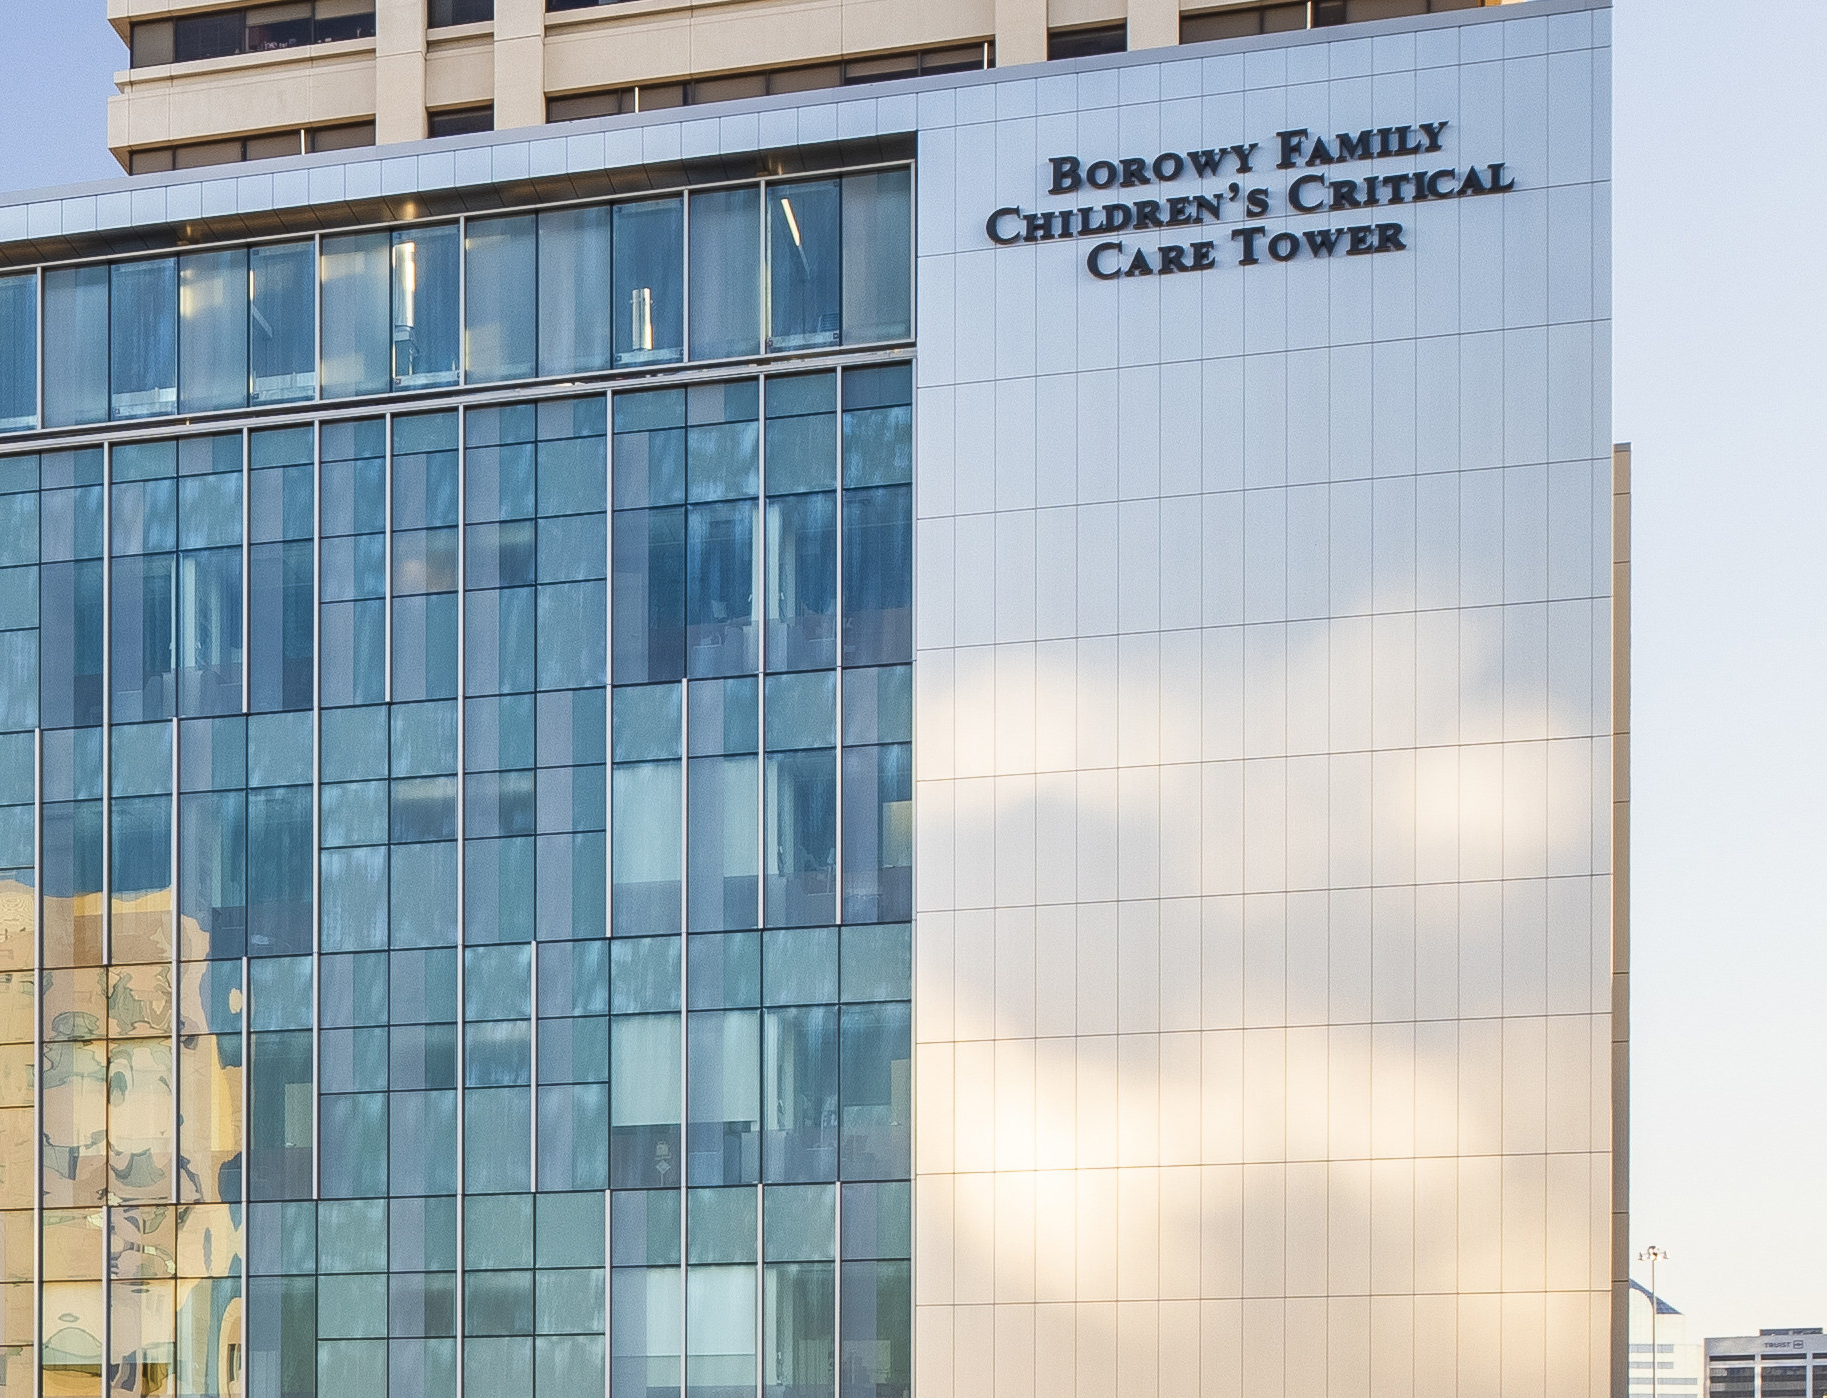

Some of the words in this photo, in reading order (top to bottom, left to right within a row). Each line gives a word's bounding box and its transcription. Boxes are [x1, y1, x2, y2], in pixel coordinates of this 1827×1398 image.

[1048, 142, 1258, 196] BOROWY
[1275, 120, 1449, 169] FAMILY
[985, 181, 1270, 245] CHILDREN'S
[1288, 162, 1515, 213] CRITICAL
[1087, 240, 1216, 280] CARE
[1231, 222, 1407, 266] TOWER
